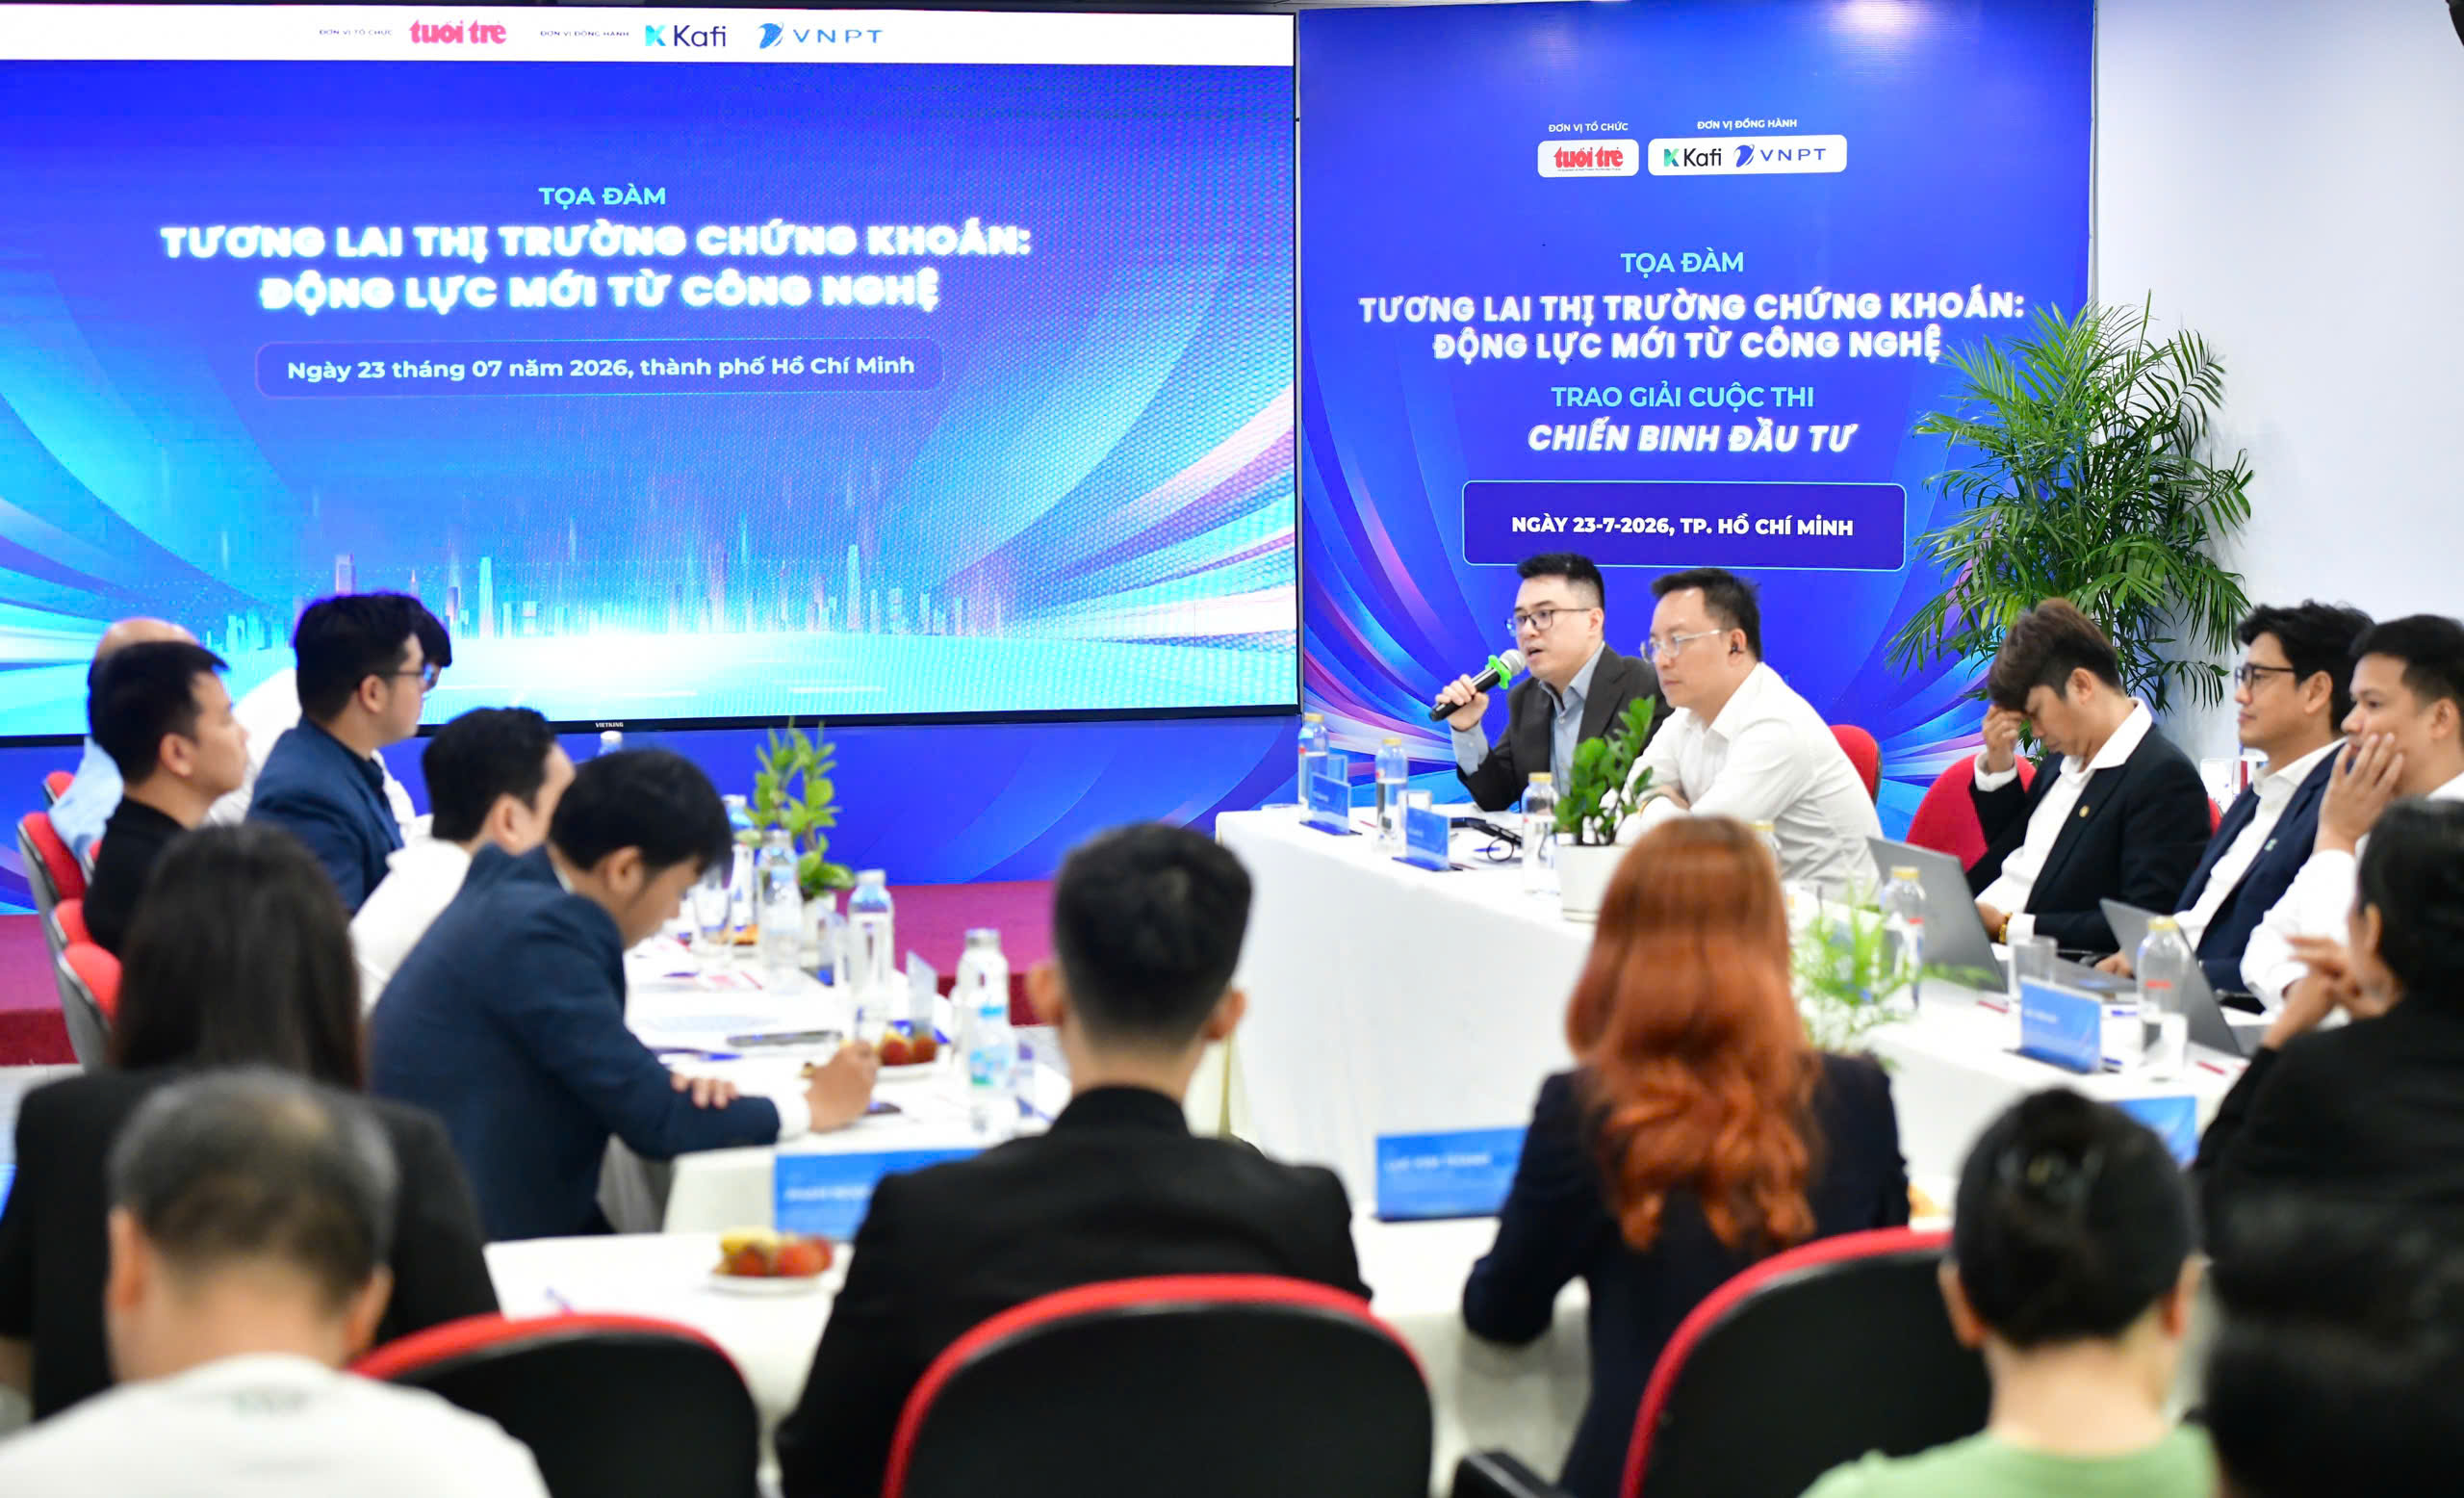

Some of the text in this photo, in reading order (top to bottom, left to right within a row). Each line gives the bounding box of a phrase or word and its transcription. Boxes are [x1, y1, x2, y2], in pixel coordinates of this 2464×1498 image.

[674, 24, 728, 48] Kafi
[792, 28, 884, 43] VNPT
[1548, 121, 1629, 134] ĐƠN VỊ TỔ CHỨC
[1697, 118, 1798, 131] ĐƠN VỊ ĐỒNG HÀNH
[1683, 147, 1722, 167] Kafi
[1760, 148, 1826, 162] VNPT
[538, 183, 667, 210] TỌA ĐÀM
[161, 217, 1033, 264] TƯƠNG LAI THỊ TRƯỜNG CHỨNG KHOÁN:
[1621, 247, 1744, 279] TỌA ĐÀM
[259, 266, 940, 317] ĐỘNG LỰC MỚI TỪ CÔNG NGHỆ
[1359, 284, 2025, 327] TƯƠNG LAI THỊ TRƯỜNG CHỨNG KHOÁN:
[1432, 323, 1941, 365] ĐỘNG LỰC MỚI TỪ CÔNG NGHỆ
[288, 355, 915, 383] Ngày 23 tháng 07 năm 2026, thành phố Hồ Chí Minh
[1551, 380, 1814, 413] TRAO GIẢI CUỘC THI
[1527, 416, 1859, 452] CHIẾN BINH ĐẦU TƯ
[1512, 513, 1567, 532] NGÀY
[1572, 517, 1675, 536] 23-7-2026,
[1681, 518, 1712, 533] TP.
[1718, 512, 1748, 534] HỒ
[1755, 515, 1791, 535] CHÍ
